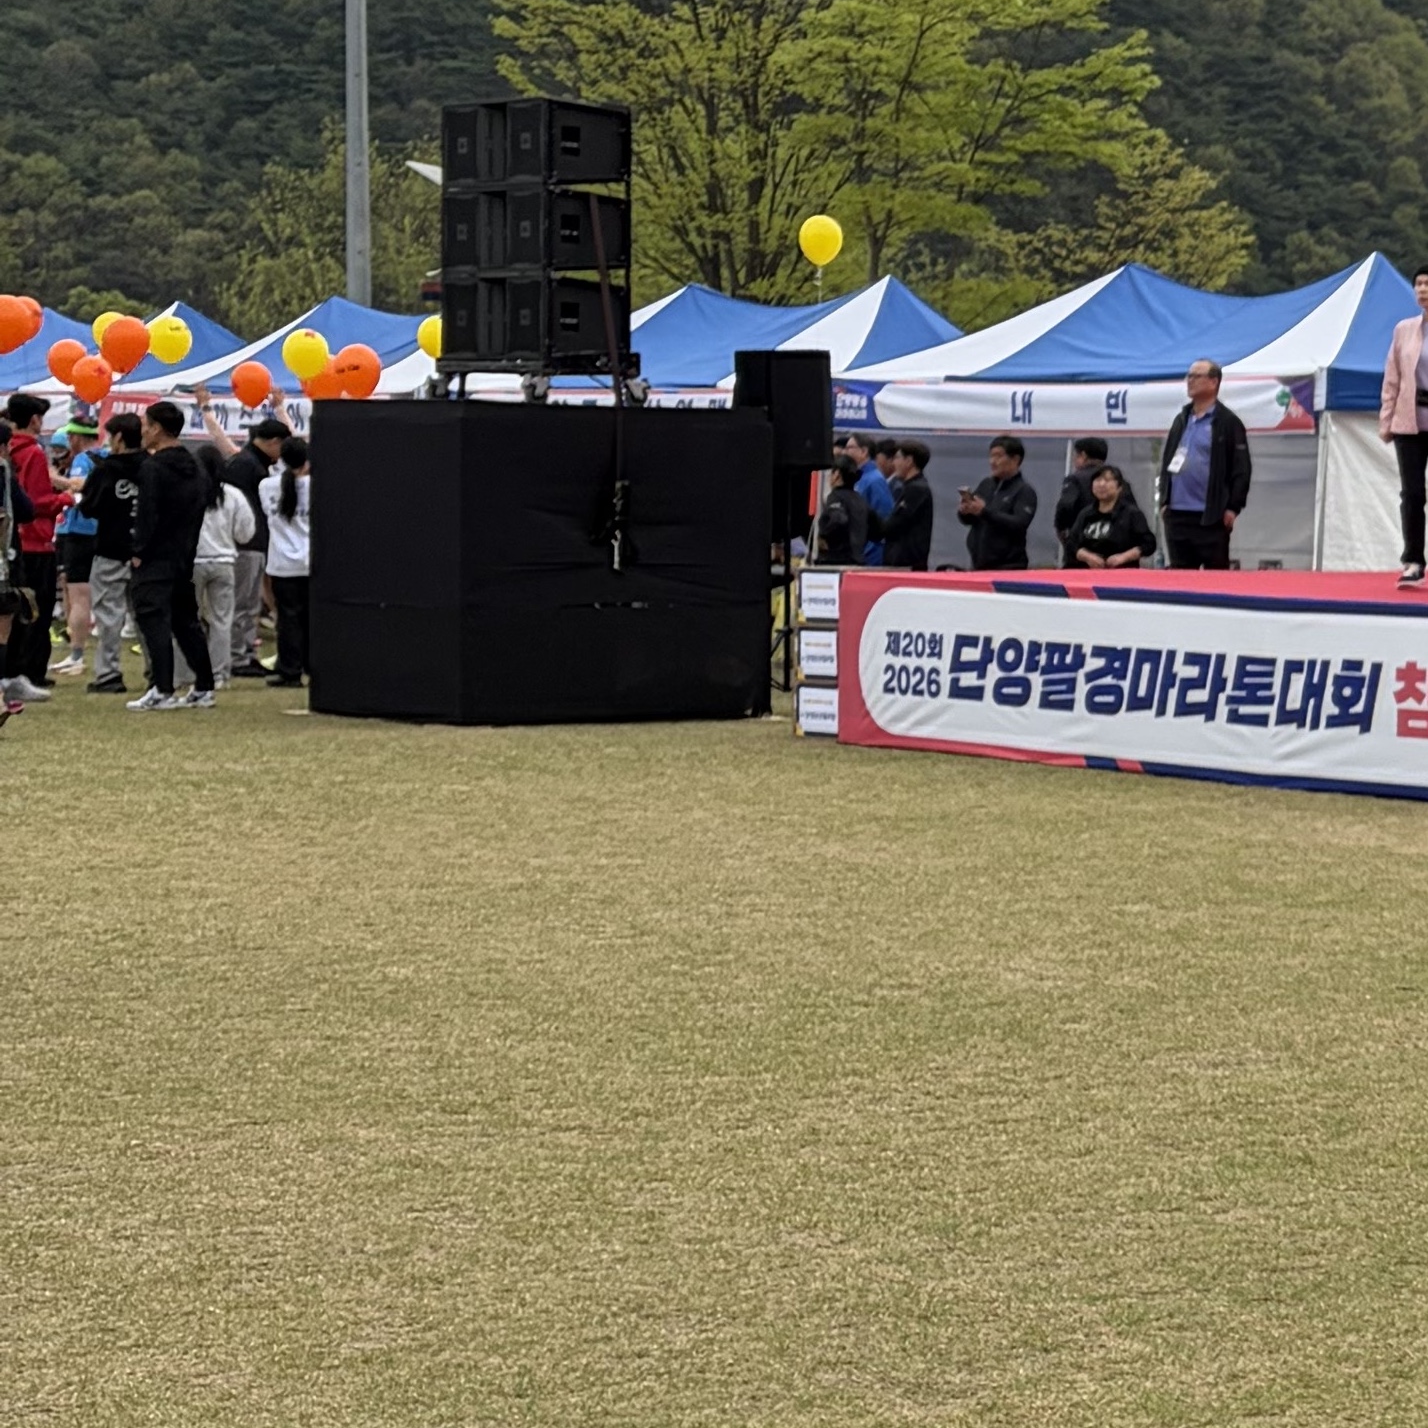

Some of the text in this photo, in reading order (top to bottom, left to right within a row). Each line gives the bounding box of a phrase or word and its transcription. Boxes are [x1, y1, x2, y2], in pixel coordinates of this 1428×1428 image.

[1011, 389, 1128, 425] 내 빈
[883, 629, 944, 661] 제20회
[882, 664, 942, 700] 2026
[947, 632, 1384, 735] 단양팔경마라톤대회
